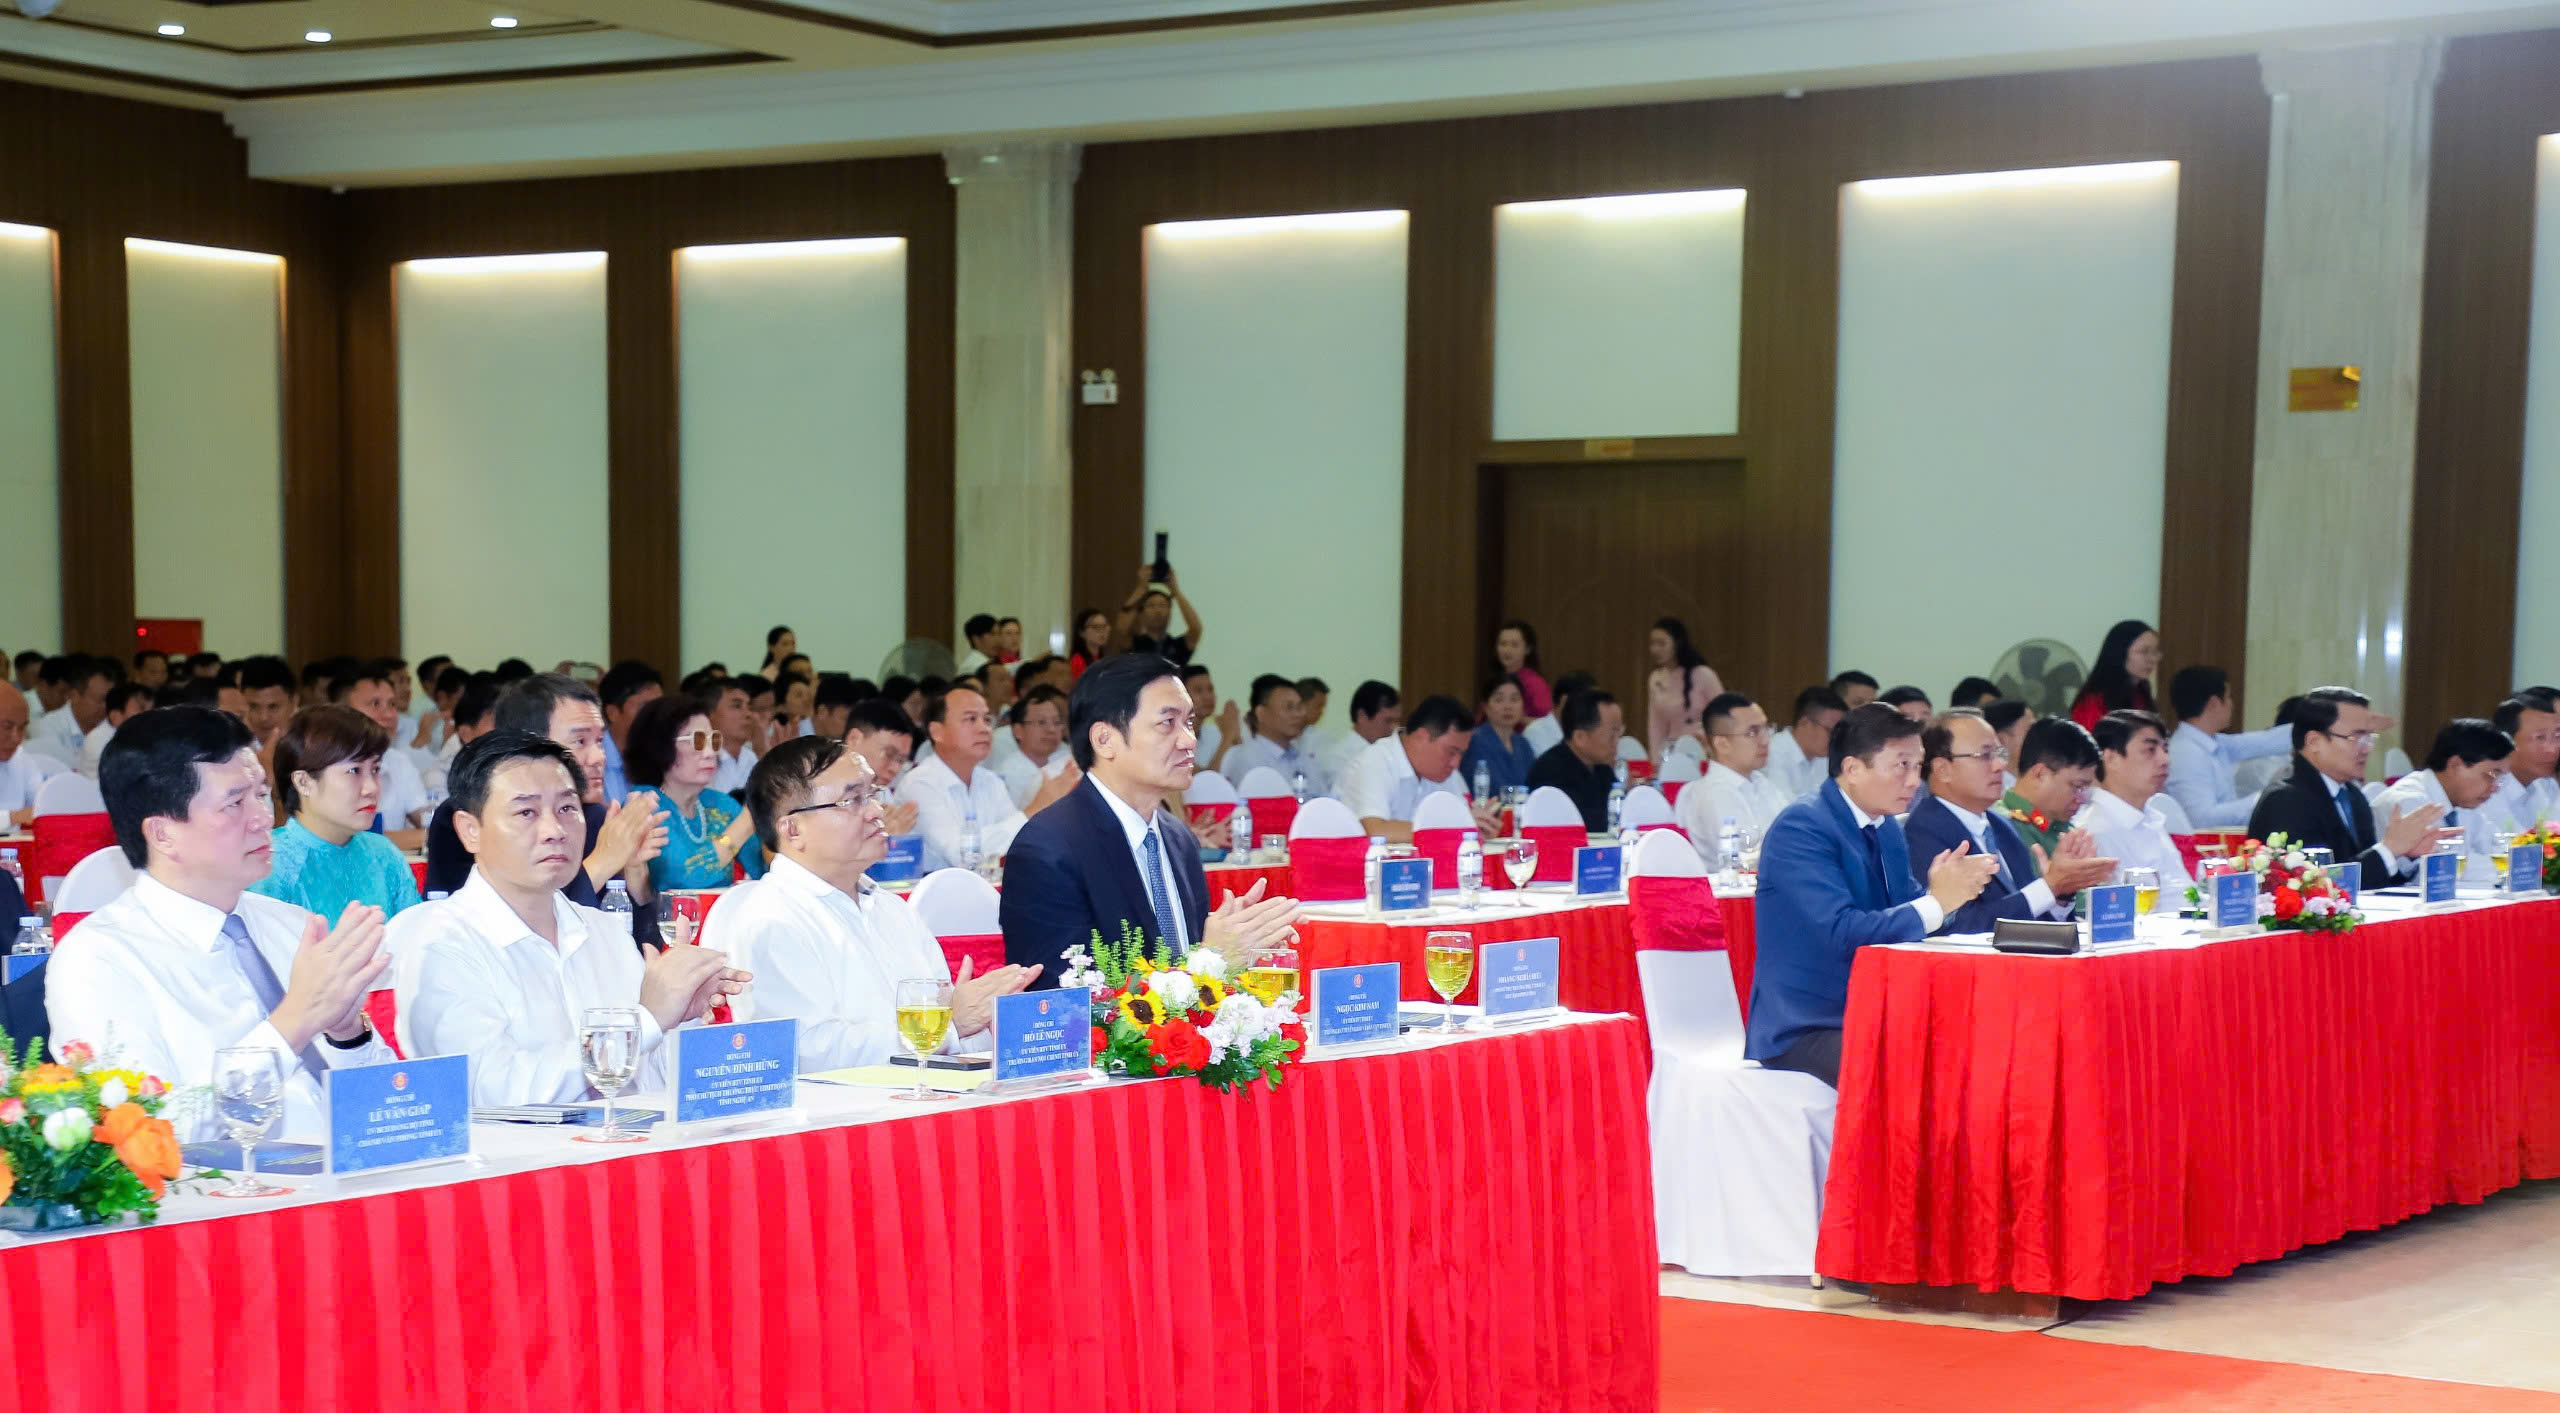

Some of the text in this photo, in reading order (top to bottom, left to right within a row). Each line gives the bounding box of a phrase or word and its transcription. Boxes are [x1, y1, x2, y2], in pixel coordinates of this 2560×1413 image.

[1035, 1029, 1045, 1041] LÊ
[1046, 1029, 1064, 1041] NGỌC
[369, 1103, 432, 1122] LÊ VĂN GIÁP
